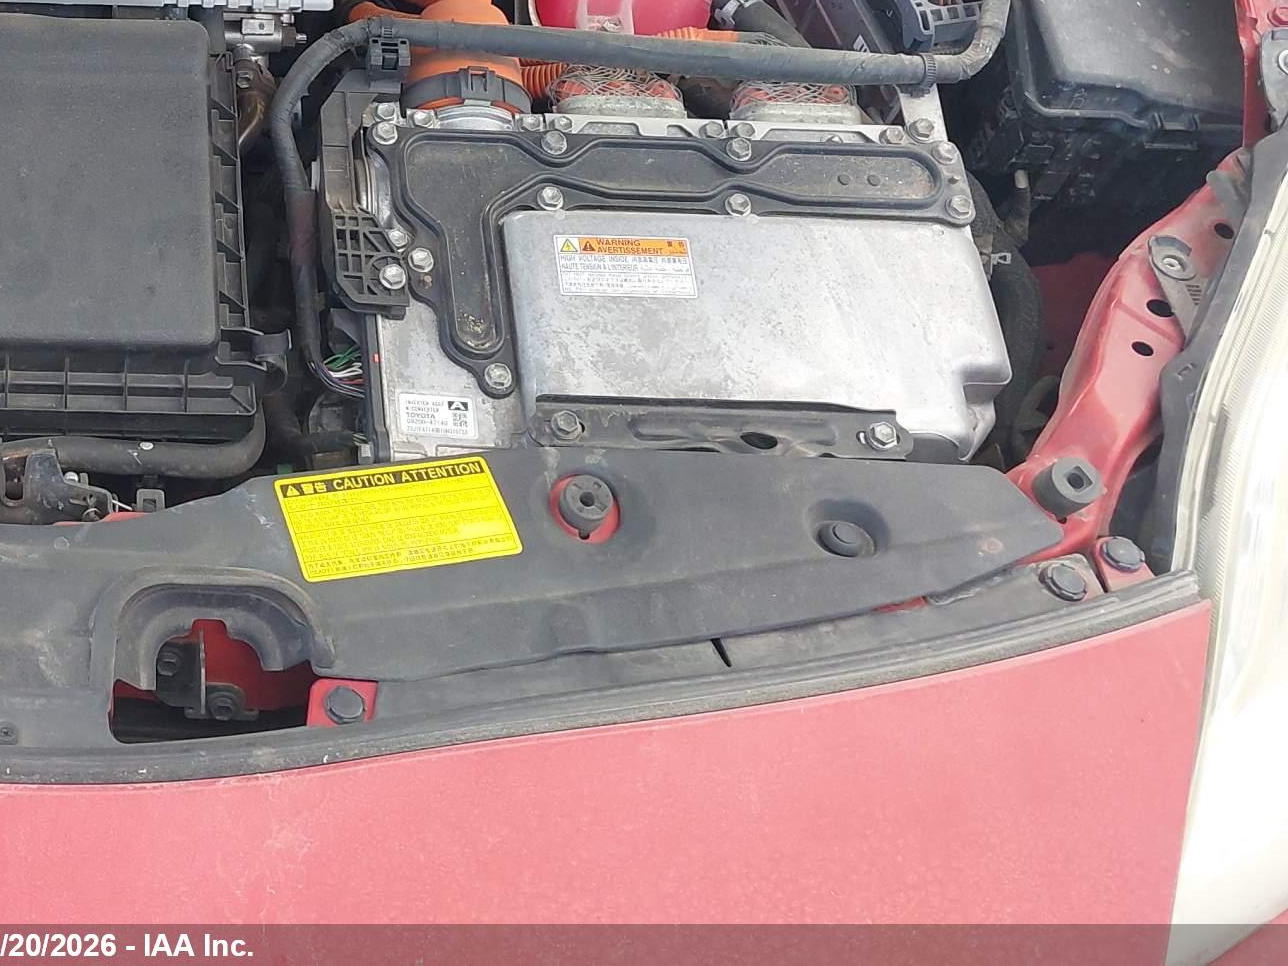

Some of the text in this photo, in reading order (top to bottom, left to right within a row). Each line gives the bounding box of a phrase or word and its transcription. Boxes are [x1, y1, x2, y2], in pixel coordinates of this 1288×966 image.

[596, 238, 641, 247] WARNING
[332, 472, 396, 491] CAUTION
[400, 461, 482, 483] ATTENTION
